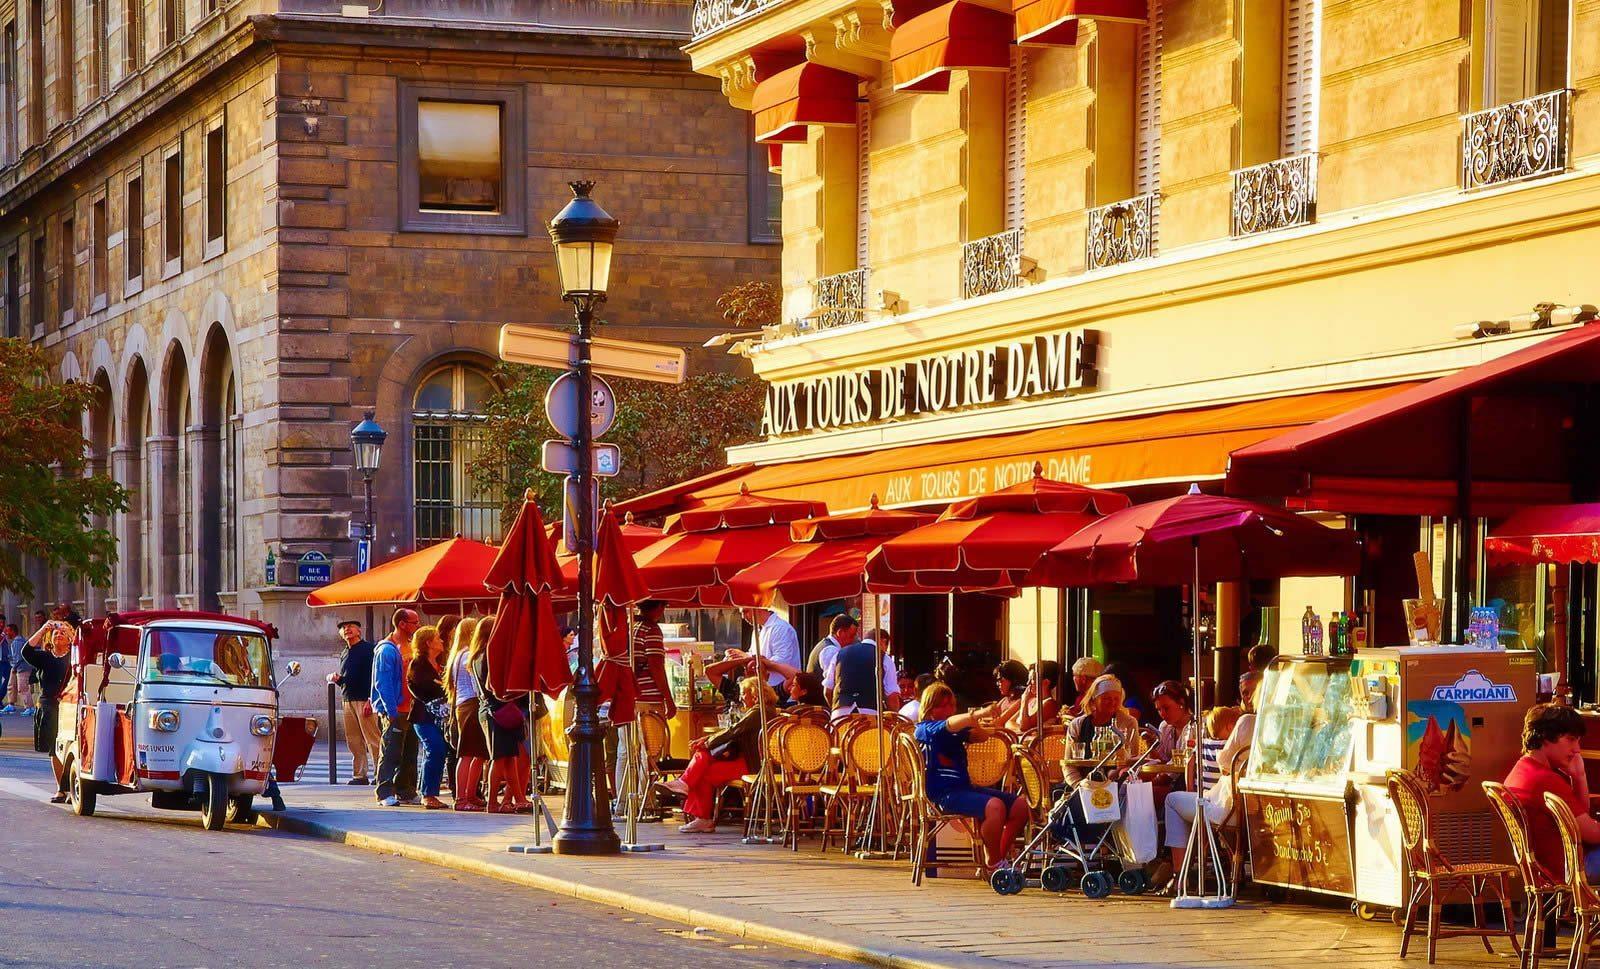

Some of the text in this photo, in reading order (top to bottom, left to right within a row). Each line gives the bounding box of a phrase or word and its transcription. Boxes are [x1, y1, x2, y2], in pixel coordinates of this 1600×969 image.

[759, 329, 1085, 436] AUX TOURS DE NOTRE DAME
[885, 476, 912, 503] AUX
[921, 470, 960, 498] TOURS
[968, 466, 987, 494] DE
[1048, 454, 1092, 484] DAME
[1436, 687, 1509, 700] CARPIGIANI
[1265, 799, 1294, 833] Panini
